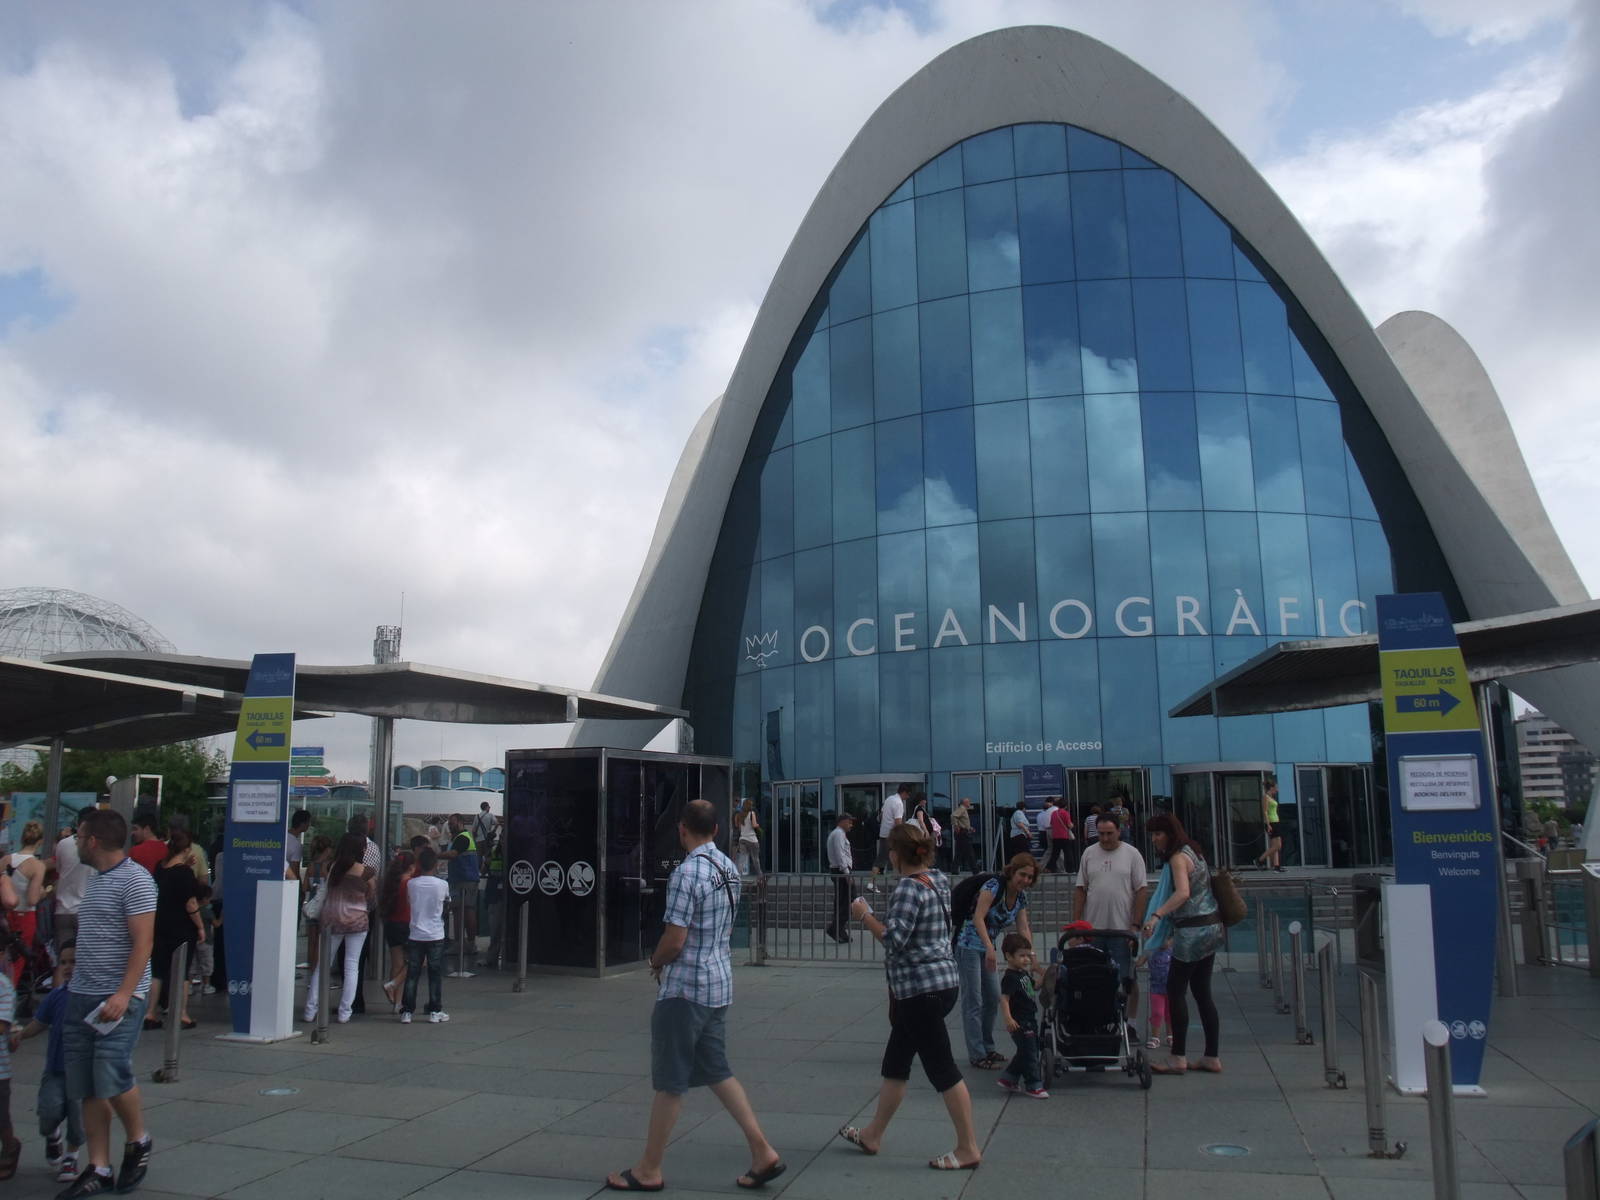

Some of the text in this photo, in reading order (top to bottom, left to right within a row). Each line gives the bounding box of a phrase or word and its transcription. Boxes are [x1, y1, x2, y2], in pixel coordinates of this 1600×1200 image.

[800, 588, 1368, 663] OCEANOGRÀFIC
[1392, 666, 1456, 680] TAQUILLAS
[1414, 698, 1440, 708] 60 m
[985, 739, 1103, 753] Edificio de Acceso
[1412, 830, 1493, 844] Bienvenidos
[232, 838, 281, 848] Bienvenidos
[1431, 850, 1480, 861] Benvinguts
[246, 866, 271, 874] Welcome
[1438, 866, 1480, 877] Welcome
